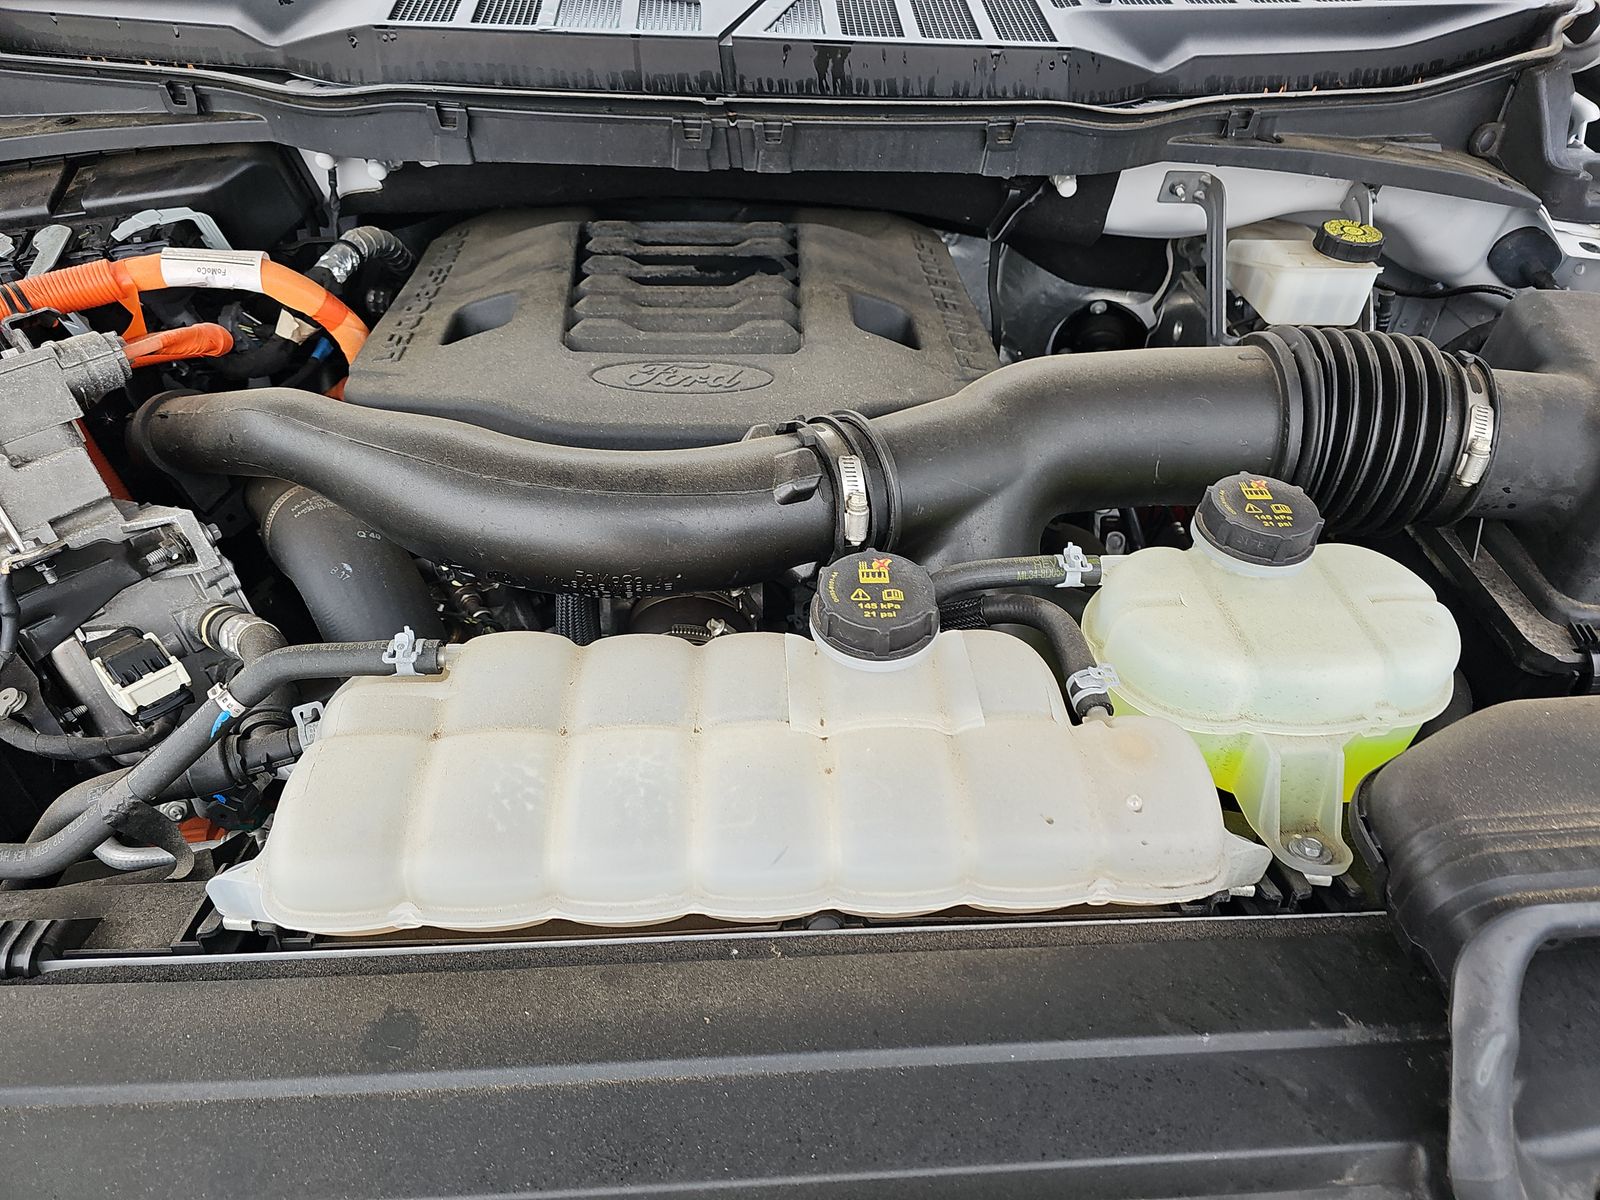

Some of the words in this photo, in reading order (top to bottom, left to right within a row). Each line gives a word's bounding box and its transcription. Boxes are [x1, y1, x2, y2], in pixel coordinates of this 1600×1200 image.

[196, 267, 227, 276] FoMoCo
[625, 363, 743, 389] Ford
[858, 602, 878, 610] 145
[880, 602, 902, 610] kPa
[880, 610, 897, 619] psi
